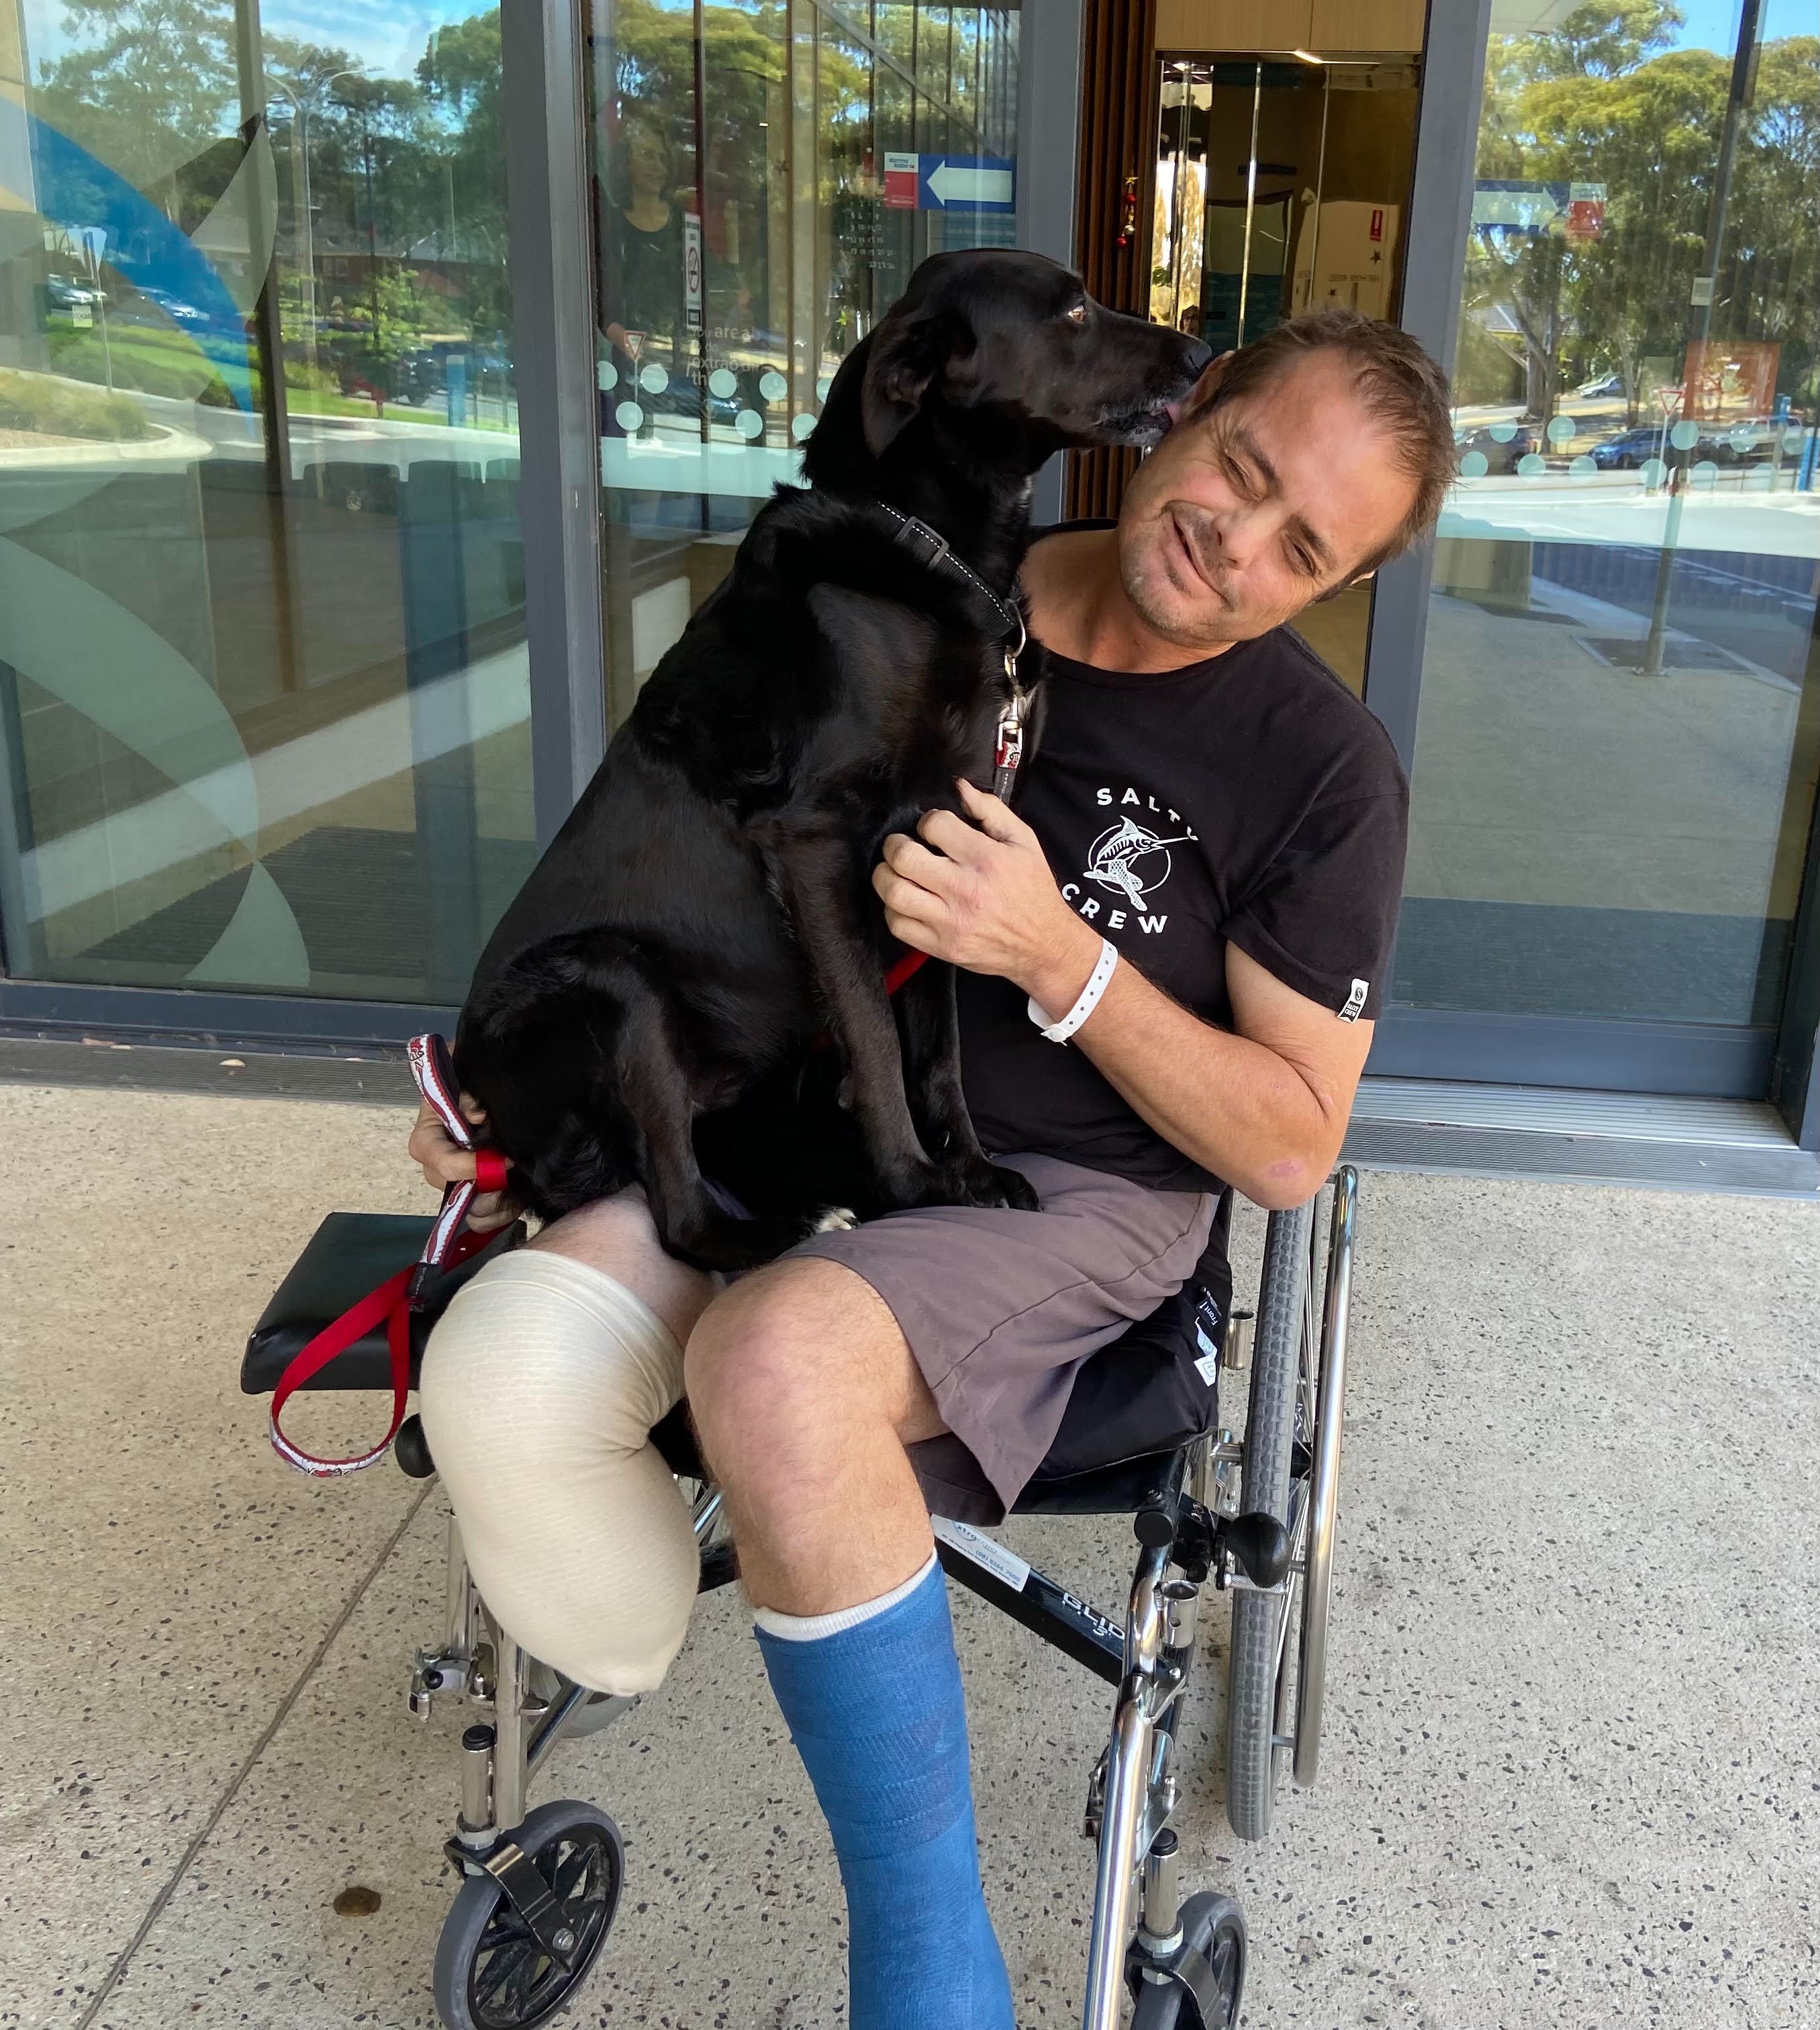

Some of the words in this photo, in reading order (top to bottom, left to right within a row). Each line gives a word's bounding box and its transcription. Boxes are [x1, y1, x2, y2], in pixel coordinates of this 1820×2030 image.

[714, 326, 738, 338] are
[1061, 883, 1168, 934] CREW
[1204, 1306, 1218, 1326] Front
[957, 1525, 977, 1541] xtra
